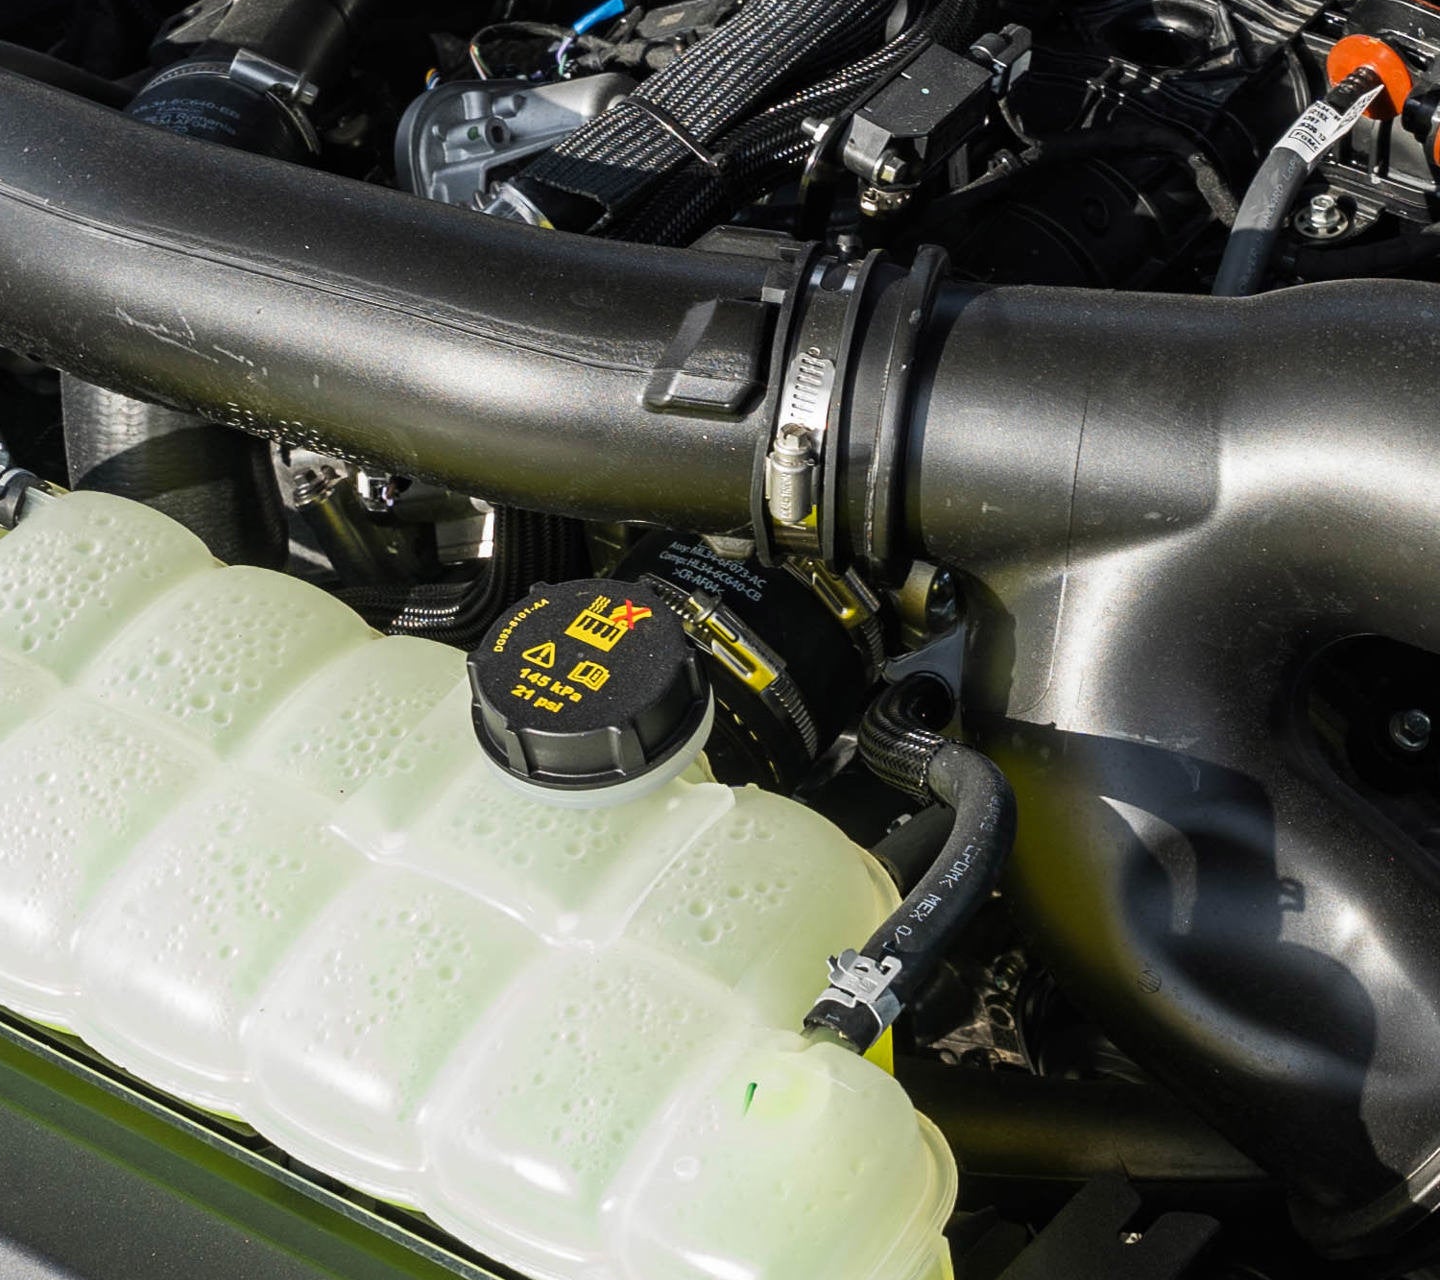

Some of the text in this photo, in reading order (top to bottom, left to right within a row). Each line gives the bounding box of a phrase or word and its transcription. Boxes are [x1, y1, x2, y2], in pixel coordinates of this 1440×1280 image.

[492, 598, 551, 653] DG93-8101-AA
[510, 684, 565, 714] 21 psi
[519, 667, 583, 703] 145 kPa
[908, 892, 942, 923] MEX
